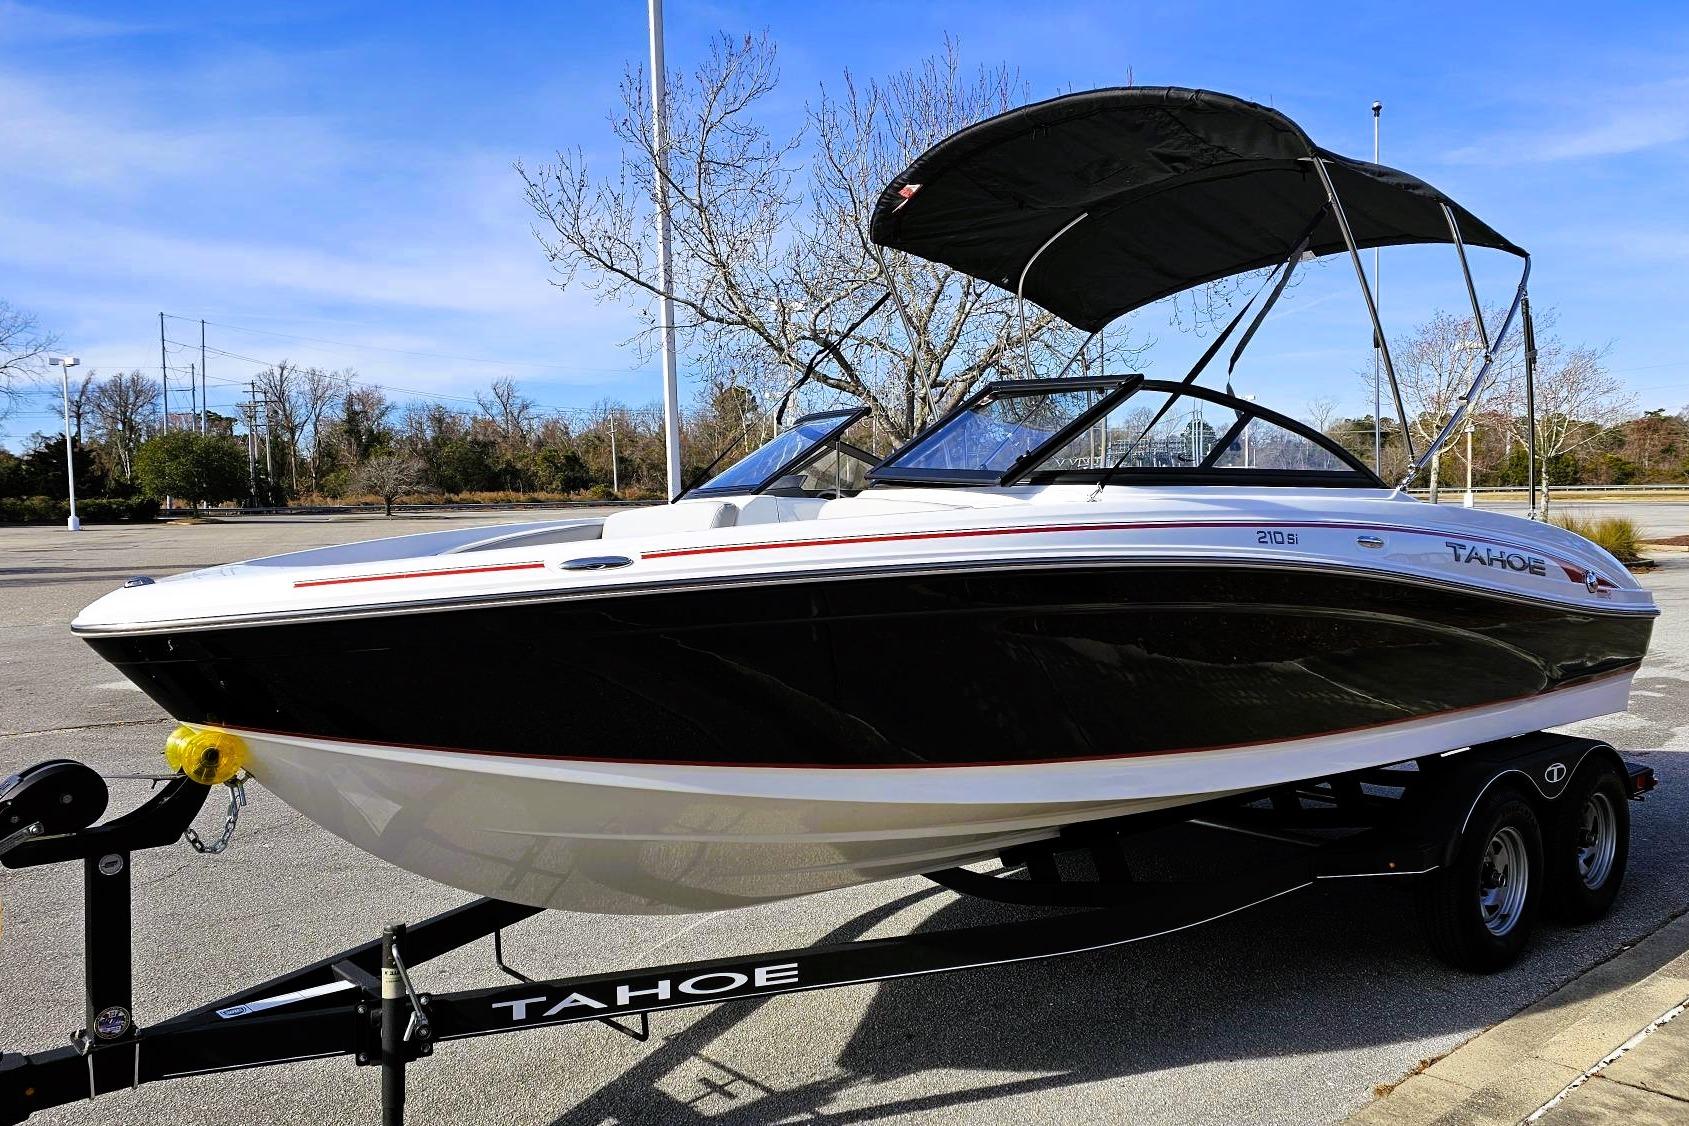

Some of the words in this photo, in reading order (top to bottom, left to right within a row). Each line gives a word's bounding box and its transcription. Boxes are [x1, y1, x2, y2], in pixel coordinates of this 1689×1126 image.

[1256, 530, 1285, 545] 210
[1445, 541, 1546, 577] TAHOE
[1546, 763, 1566, 782] T
[491, 962, 799, 1021] TAHOE
